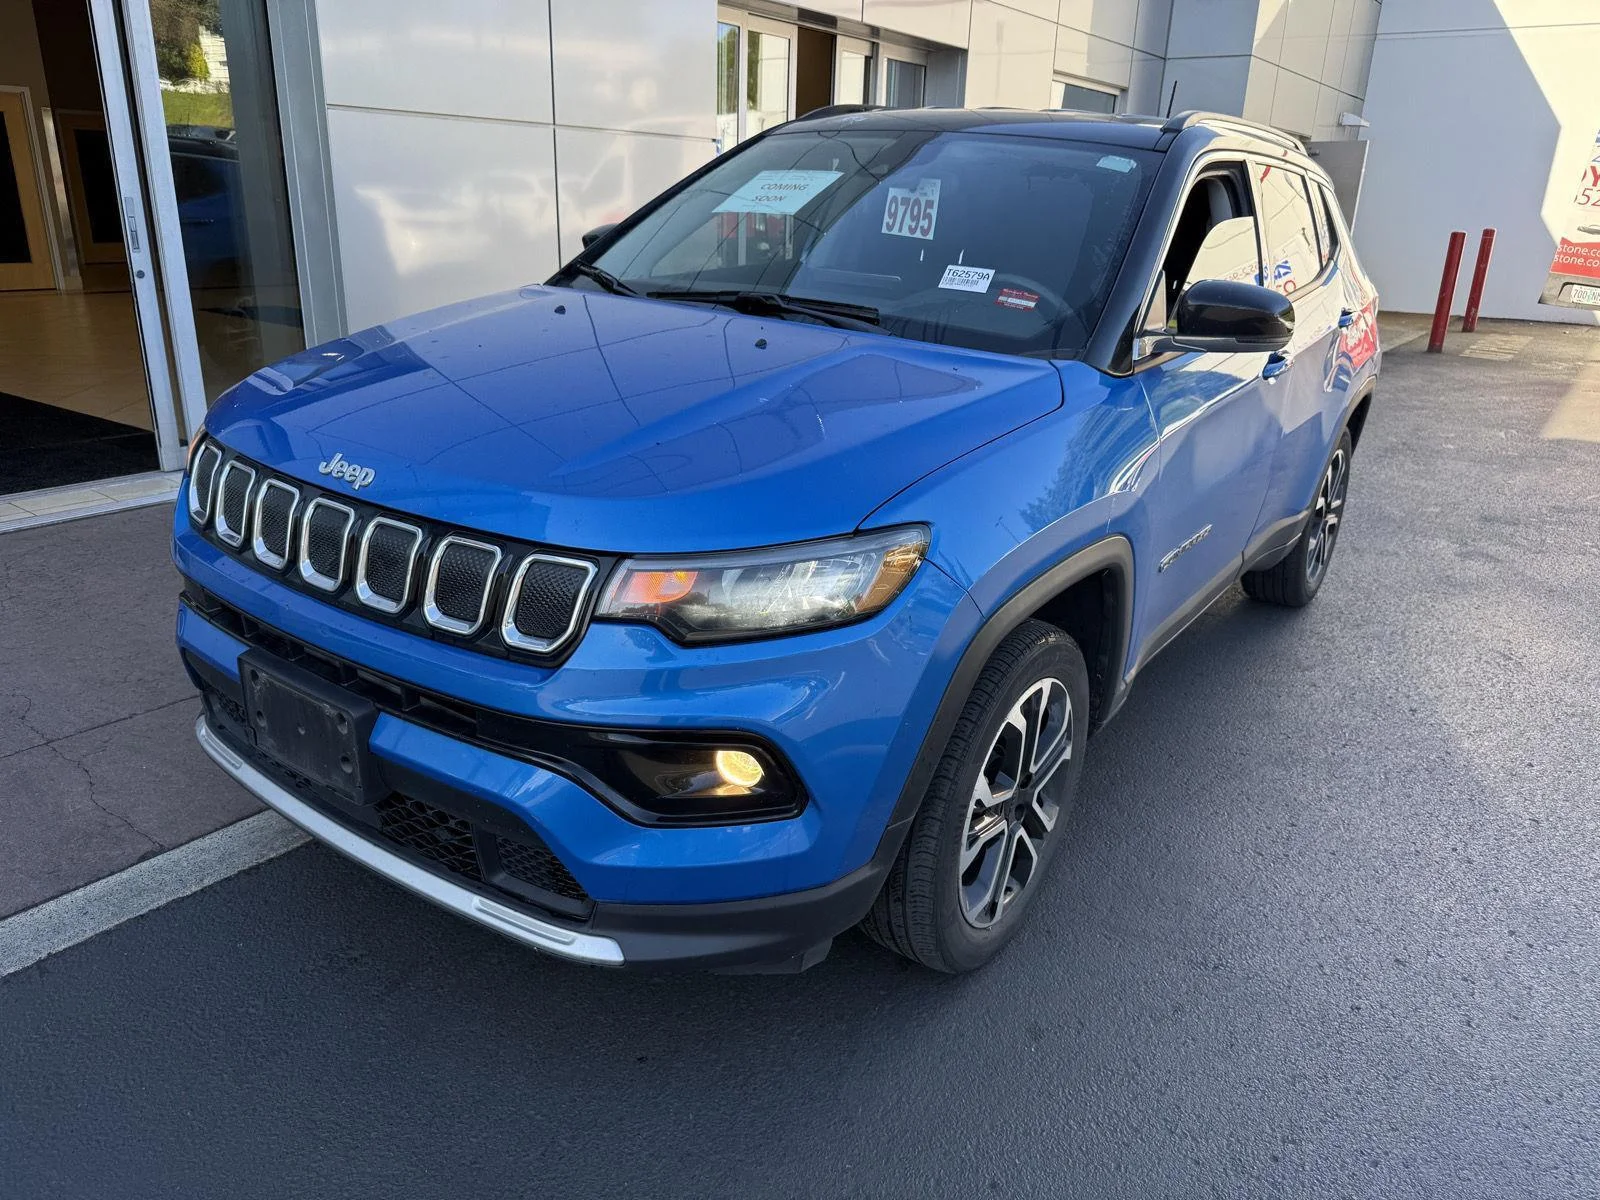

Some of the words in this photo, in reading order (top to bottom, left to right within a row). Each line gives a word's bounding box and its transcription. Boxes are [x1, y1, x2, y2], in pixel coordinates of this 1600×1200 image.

[760, 183, 809, 191] COMING
[886, 195, 934, 237] 9795
[947, 268, 990, 281] T62579A
[319, 453, 375, 490] Jeep
